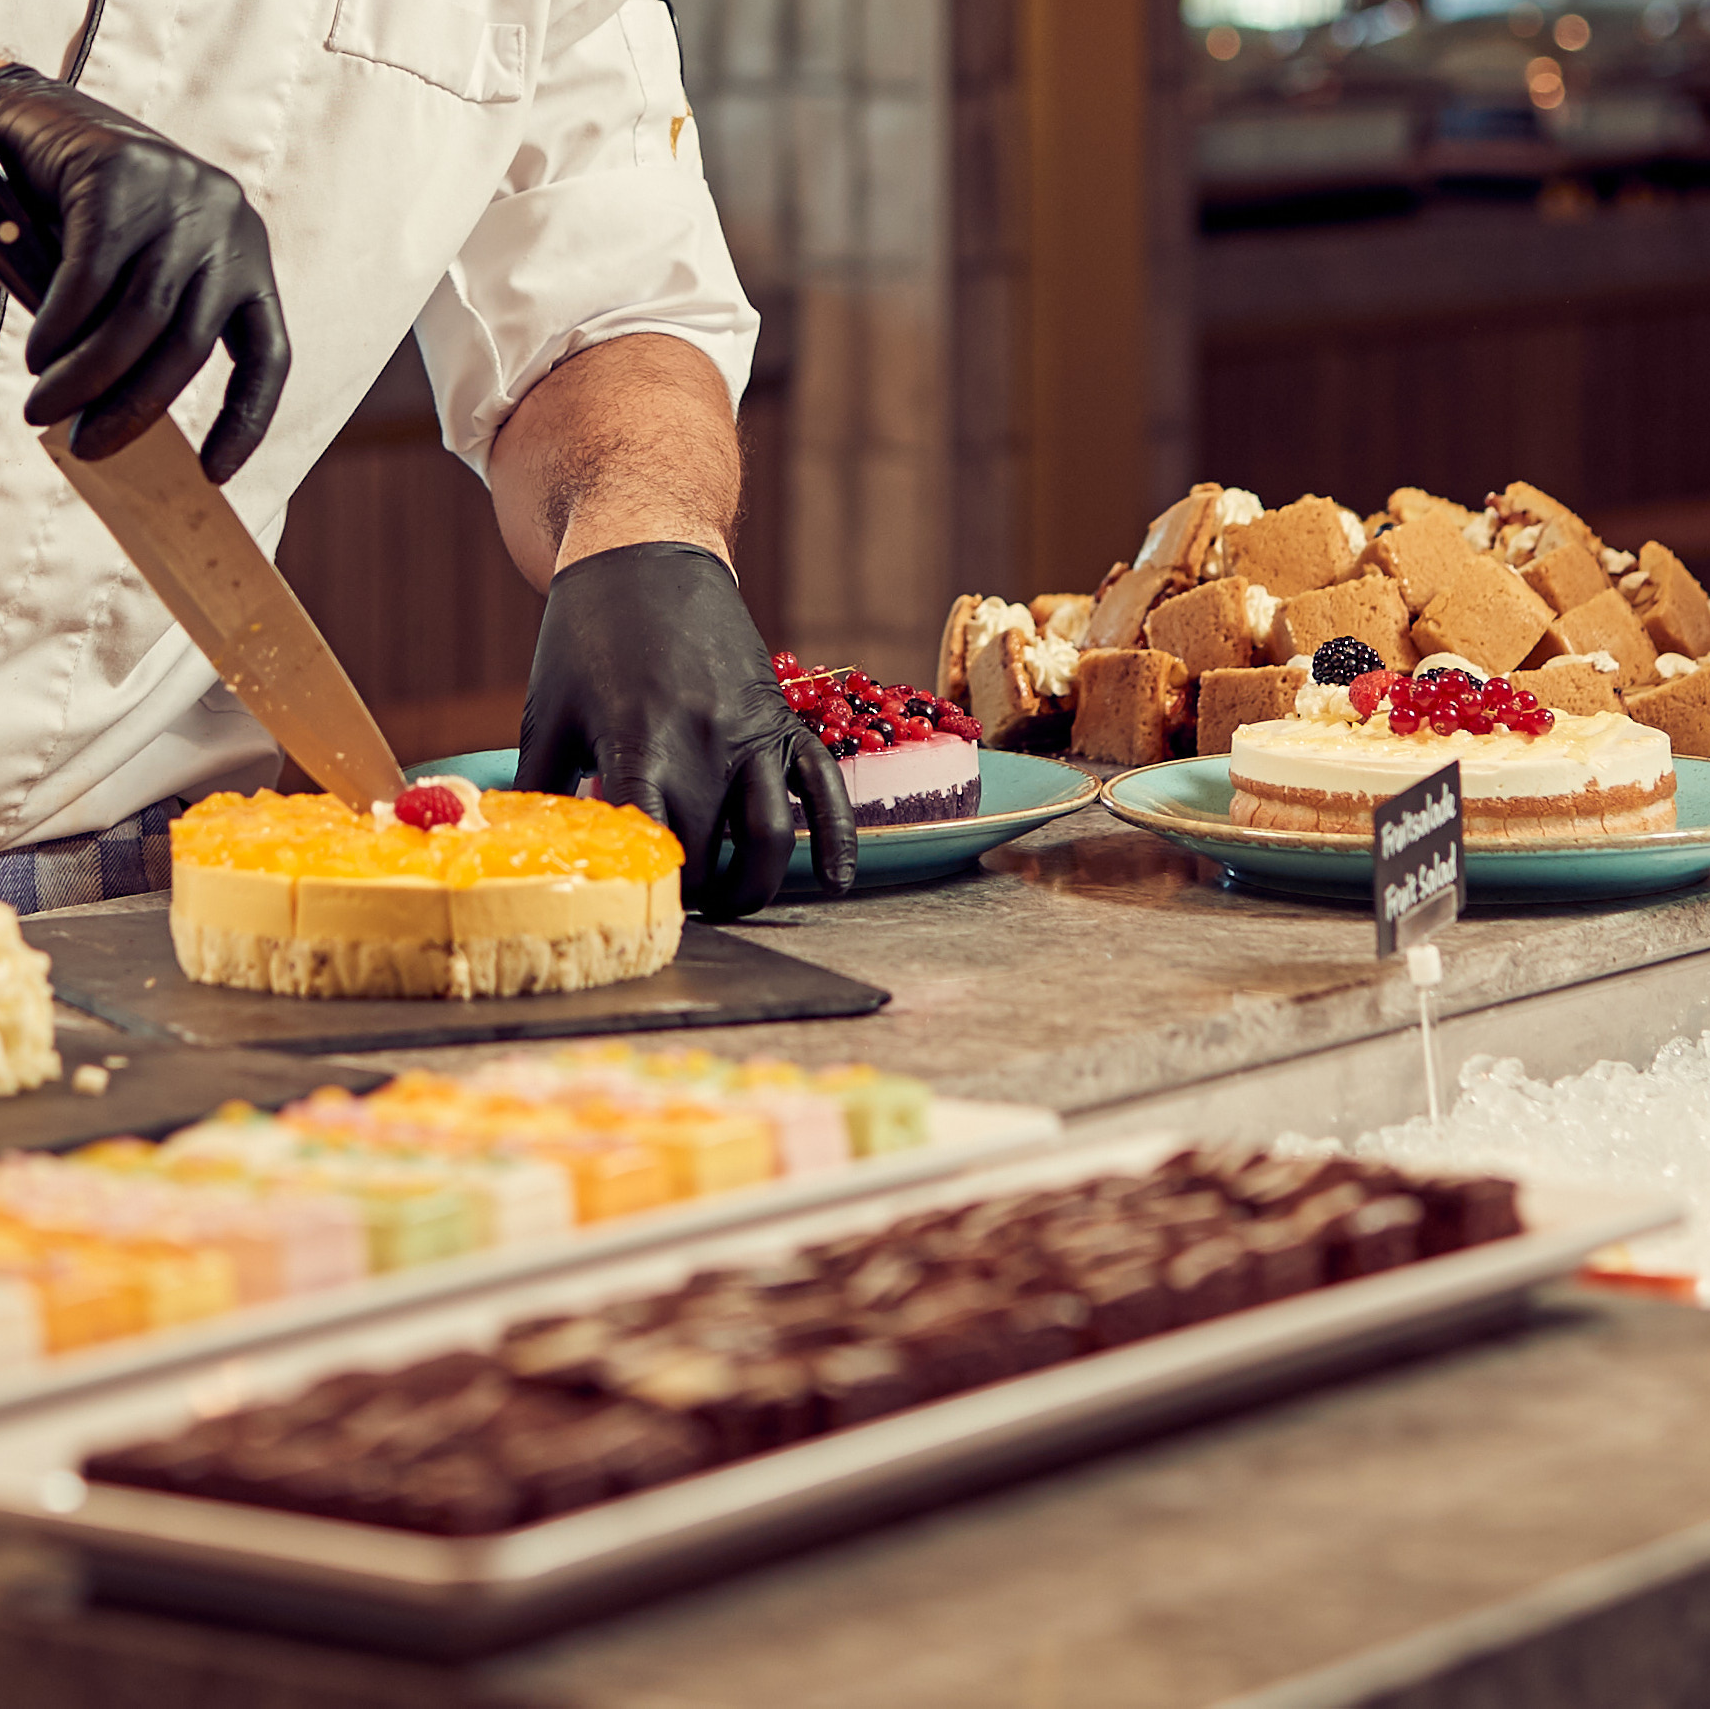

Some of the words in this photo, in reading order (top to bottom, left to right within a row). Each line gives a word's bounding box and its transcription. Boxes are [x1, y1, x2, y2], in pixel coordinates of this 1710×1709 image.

[1381, 782, 1457, 861] Fruitsalade
[1384, 872, 1418, 922] Fruit
[1418, 841, 1458, 900] Salad
